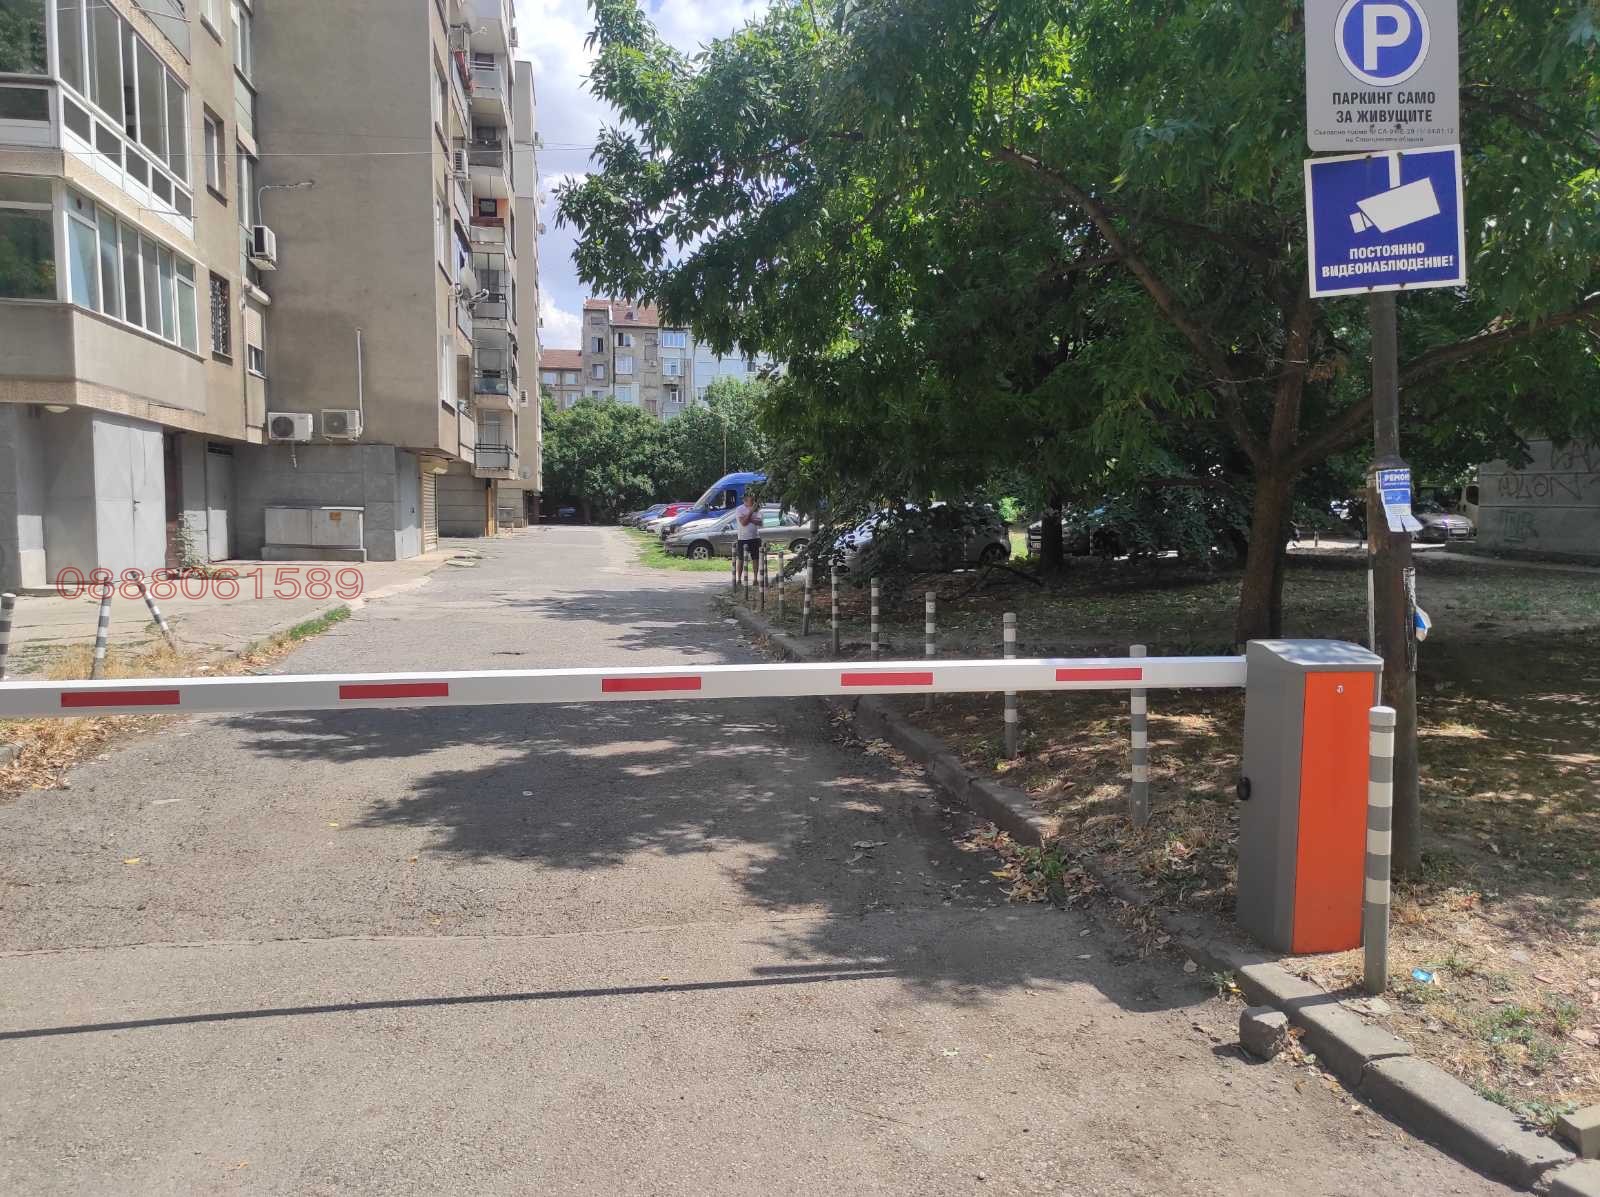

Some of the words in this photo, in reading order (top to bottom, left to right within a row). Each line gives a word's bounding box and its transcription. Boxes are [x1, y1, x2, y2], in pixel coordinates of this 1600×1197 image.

[1332, 92, 1393, 105] ПАРКИНГ
[1397, 91, 1436, 105] САМО
[1336, 110, 1353, 123] ЗА
[1356, 109, 1433, 124] ЖИВУЩИТЕ
[1349, 242, 1425, 260] ПОСТОЯННО
[1321, 255, 1454, 278] ВИДЕОНАБЛЮДЕНИЕ!
